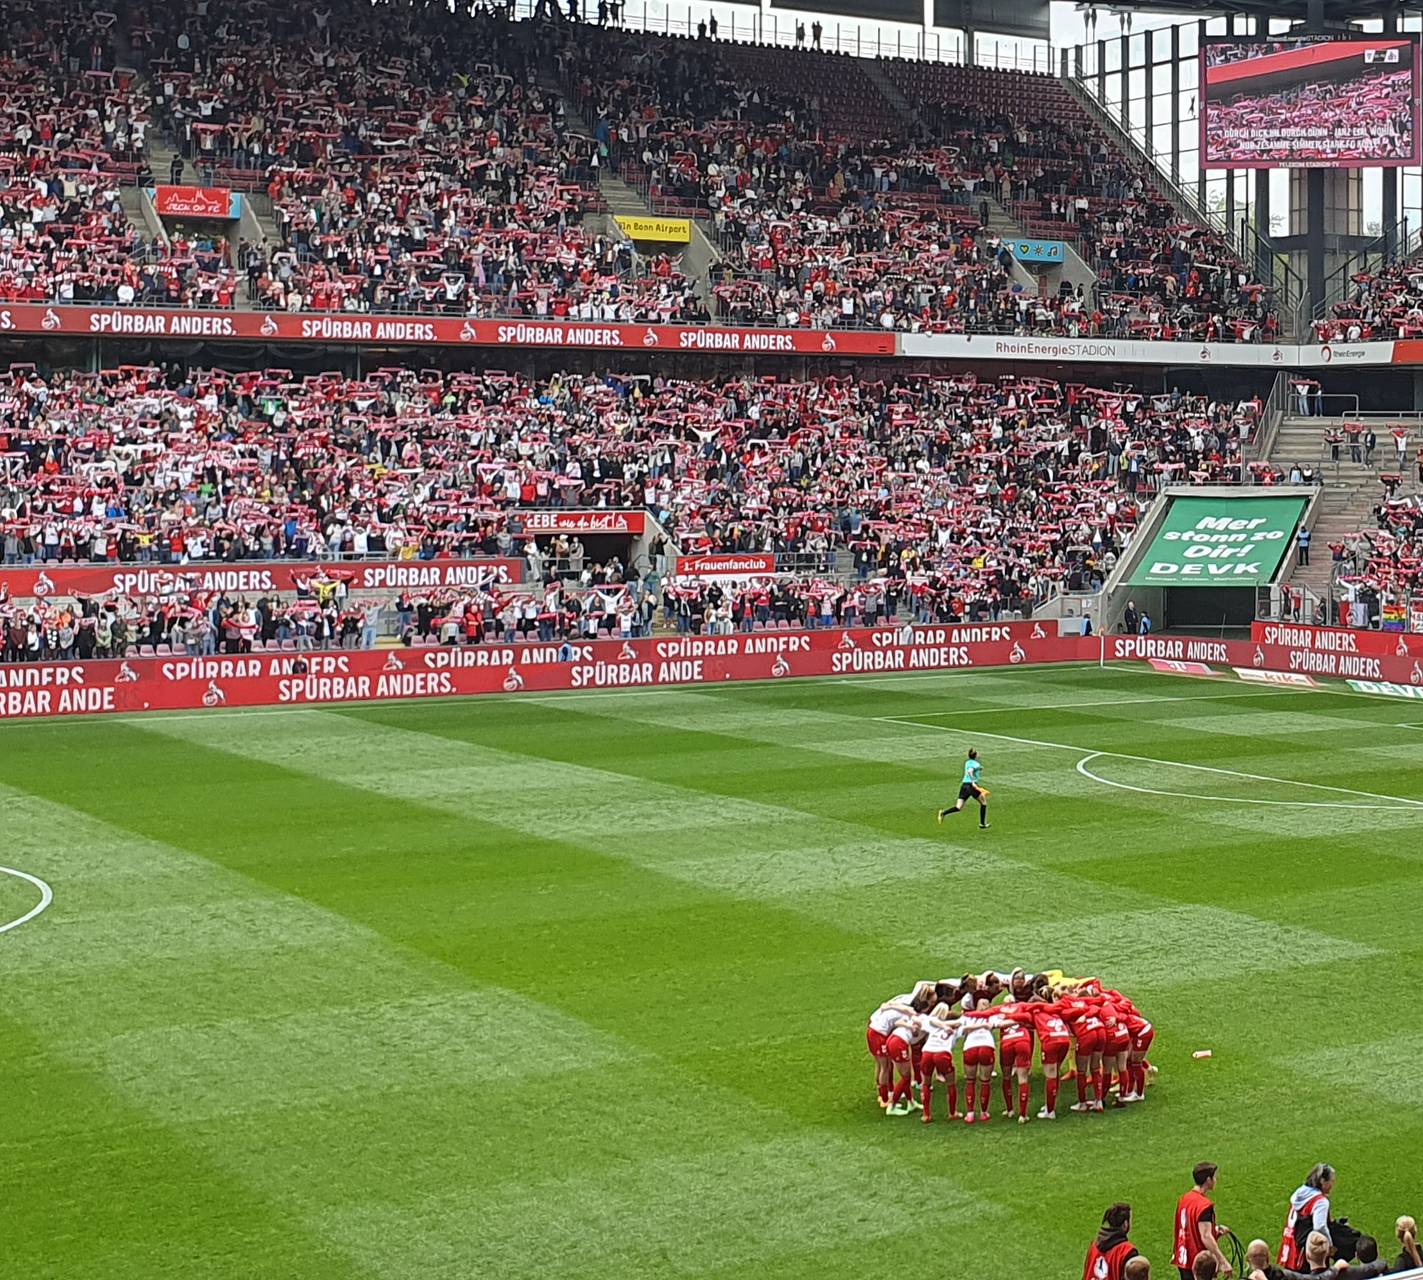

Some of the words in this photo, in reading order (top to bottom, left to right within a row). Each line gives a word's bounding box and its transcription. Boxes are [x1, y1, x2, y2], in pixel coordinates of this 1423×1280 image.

[633, 222, 654, 231] Bonn
[655, 223, 687, 234] Airport
[90, 311, 166, 334] SPÜRBAR
[169, 315, 237, 336] ANDERS.
[302, 315, 371, 339] SPÜRBAR
[376, 318, 438, 340] ANDERS.
[497, 322, 562, 345] SPÜRBAR
[566, 325, 624, 346] ANDERS.
[679, 328, 740, 350] SPÜRBAR
[744, 332, 797, 351] ANDERS.
[995, 341, 1116, 357] RheinEnergieSTADION
[1195, 516, 1267, 531] Mer
[1163, 530, 1249, 542] stonn
[1250, 530, 1285, 541] zo
[1183, 543, 1256, 558] Dir!
[363, 566, 441, 588] SPÜRBAR
[445, 565, 513, 585] ANDES.
[683, 562, 693, 571] 1.
[695, 559, 767, 571] Frauenfanclub
[1150, 562, 1263, 575] DEVK
[203, 570, 276, 591] ANDERS.
[1115, 636, 1183, 659] SPÜRBAR
[1186, 642, 1230, 663] ANDERS.
[1264, 623, 1312, 647] SPÜRBAR
[1315, 629, 1360, 653] ANDERS.
[831, 649, 904, 673] SPÜRBAR
[908, 645, 973, 669] ANDERS.
[1289, 648, 1336, 673] SPÜRBAR
[1338, 655, 1383, 679] ANDERS.
[279, 676, 370, 701] SPÜRBAR
[375, 671, 457, 698] ANDERS.
[571, 662, 653, 687] SPÜRBAR
